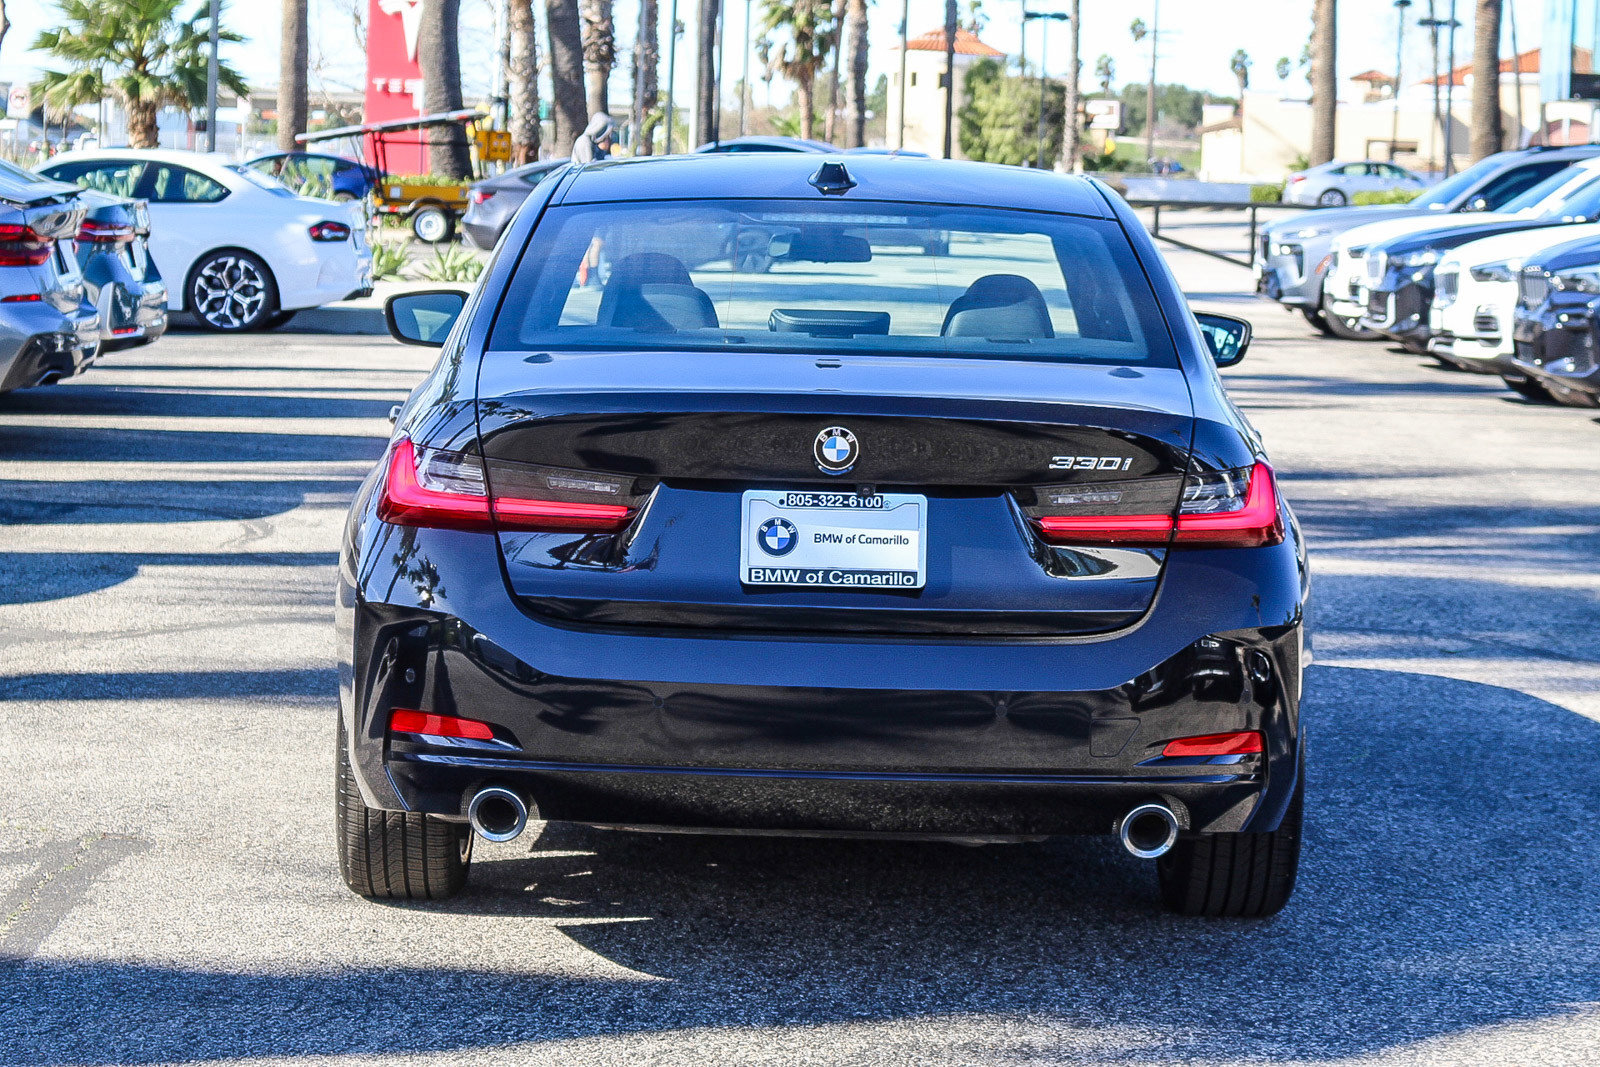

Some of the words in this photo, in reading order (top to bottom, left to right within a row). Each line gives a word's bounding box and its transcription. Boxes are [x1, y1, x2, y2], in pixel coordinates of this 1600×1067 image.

[1049, 456, 1133, 471] 330i
[788, 494, 882, 508] 805-322-6100
[814, 533, 843, 544] BMW
[845, 536, 857, 544] of
[858, 534, 909, 545] Camarillo
[751, 569, 800, 583] BMW
[805, 571, 824, 583] of
[829, 571, 915, 586] Camarillo
